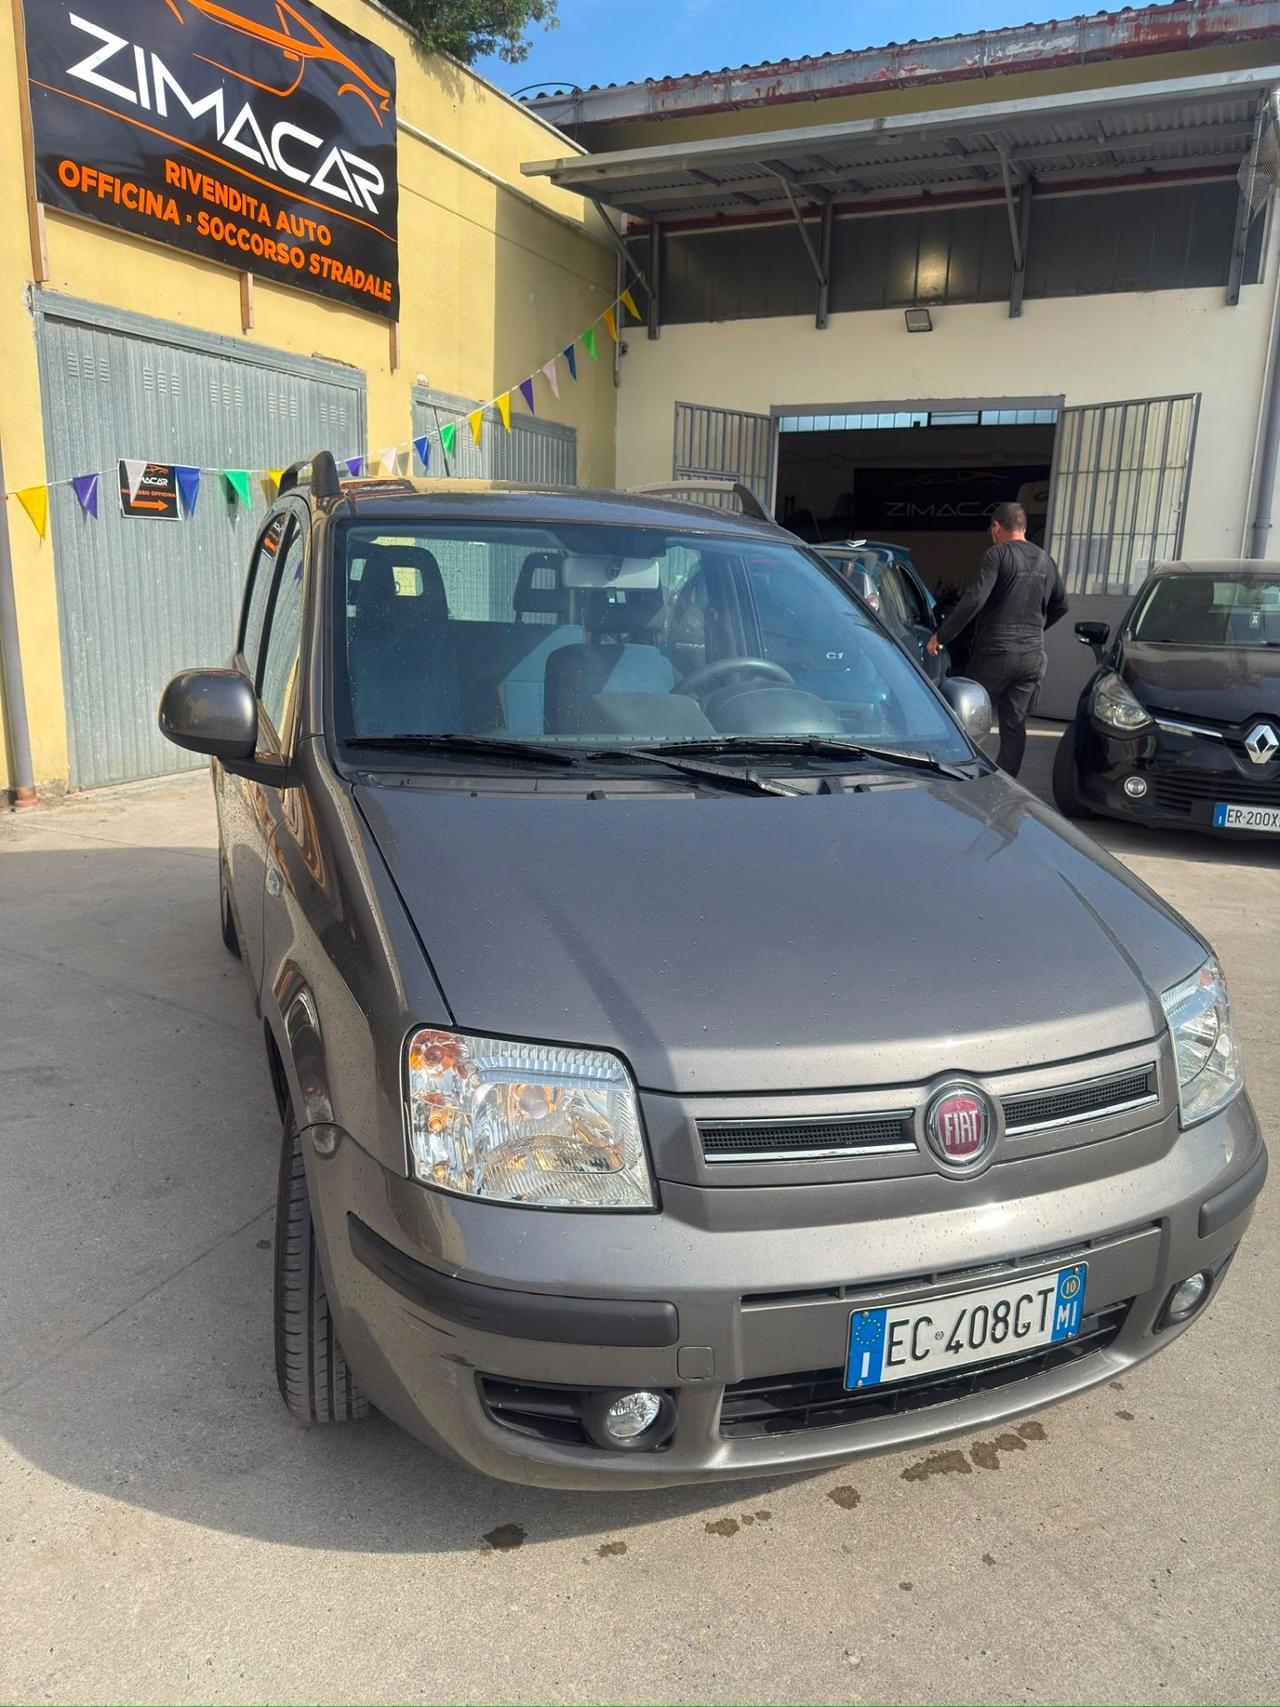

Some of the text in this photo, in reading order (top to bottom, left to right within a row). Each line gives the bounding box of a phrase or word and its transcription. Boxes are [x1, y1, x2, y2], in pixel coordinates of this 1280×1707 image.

[66, 12, 384, 214] ZIMACAR
[165, 159, 331, 246] RIVENDITA AUTO
[59, 160, 180, 226] OFFICINA
[197, 212, 305, 269] SOCCORSO
[309, 253, 392, 302] STRADALE
[884, 501, 999, 518] ZIMACA
[825, 651, 844, 660] C1
[1246, 811, 1280, 827] 200X
[944, 1109, 978, 1145] FIAT
[1057, 1302, 1077, 1331] MI
